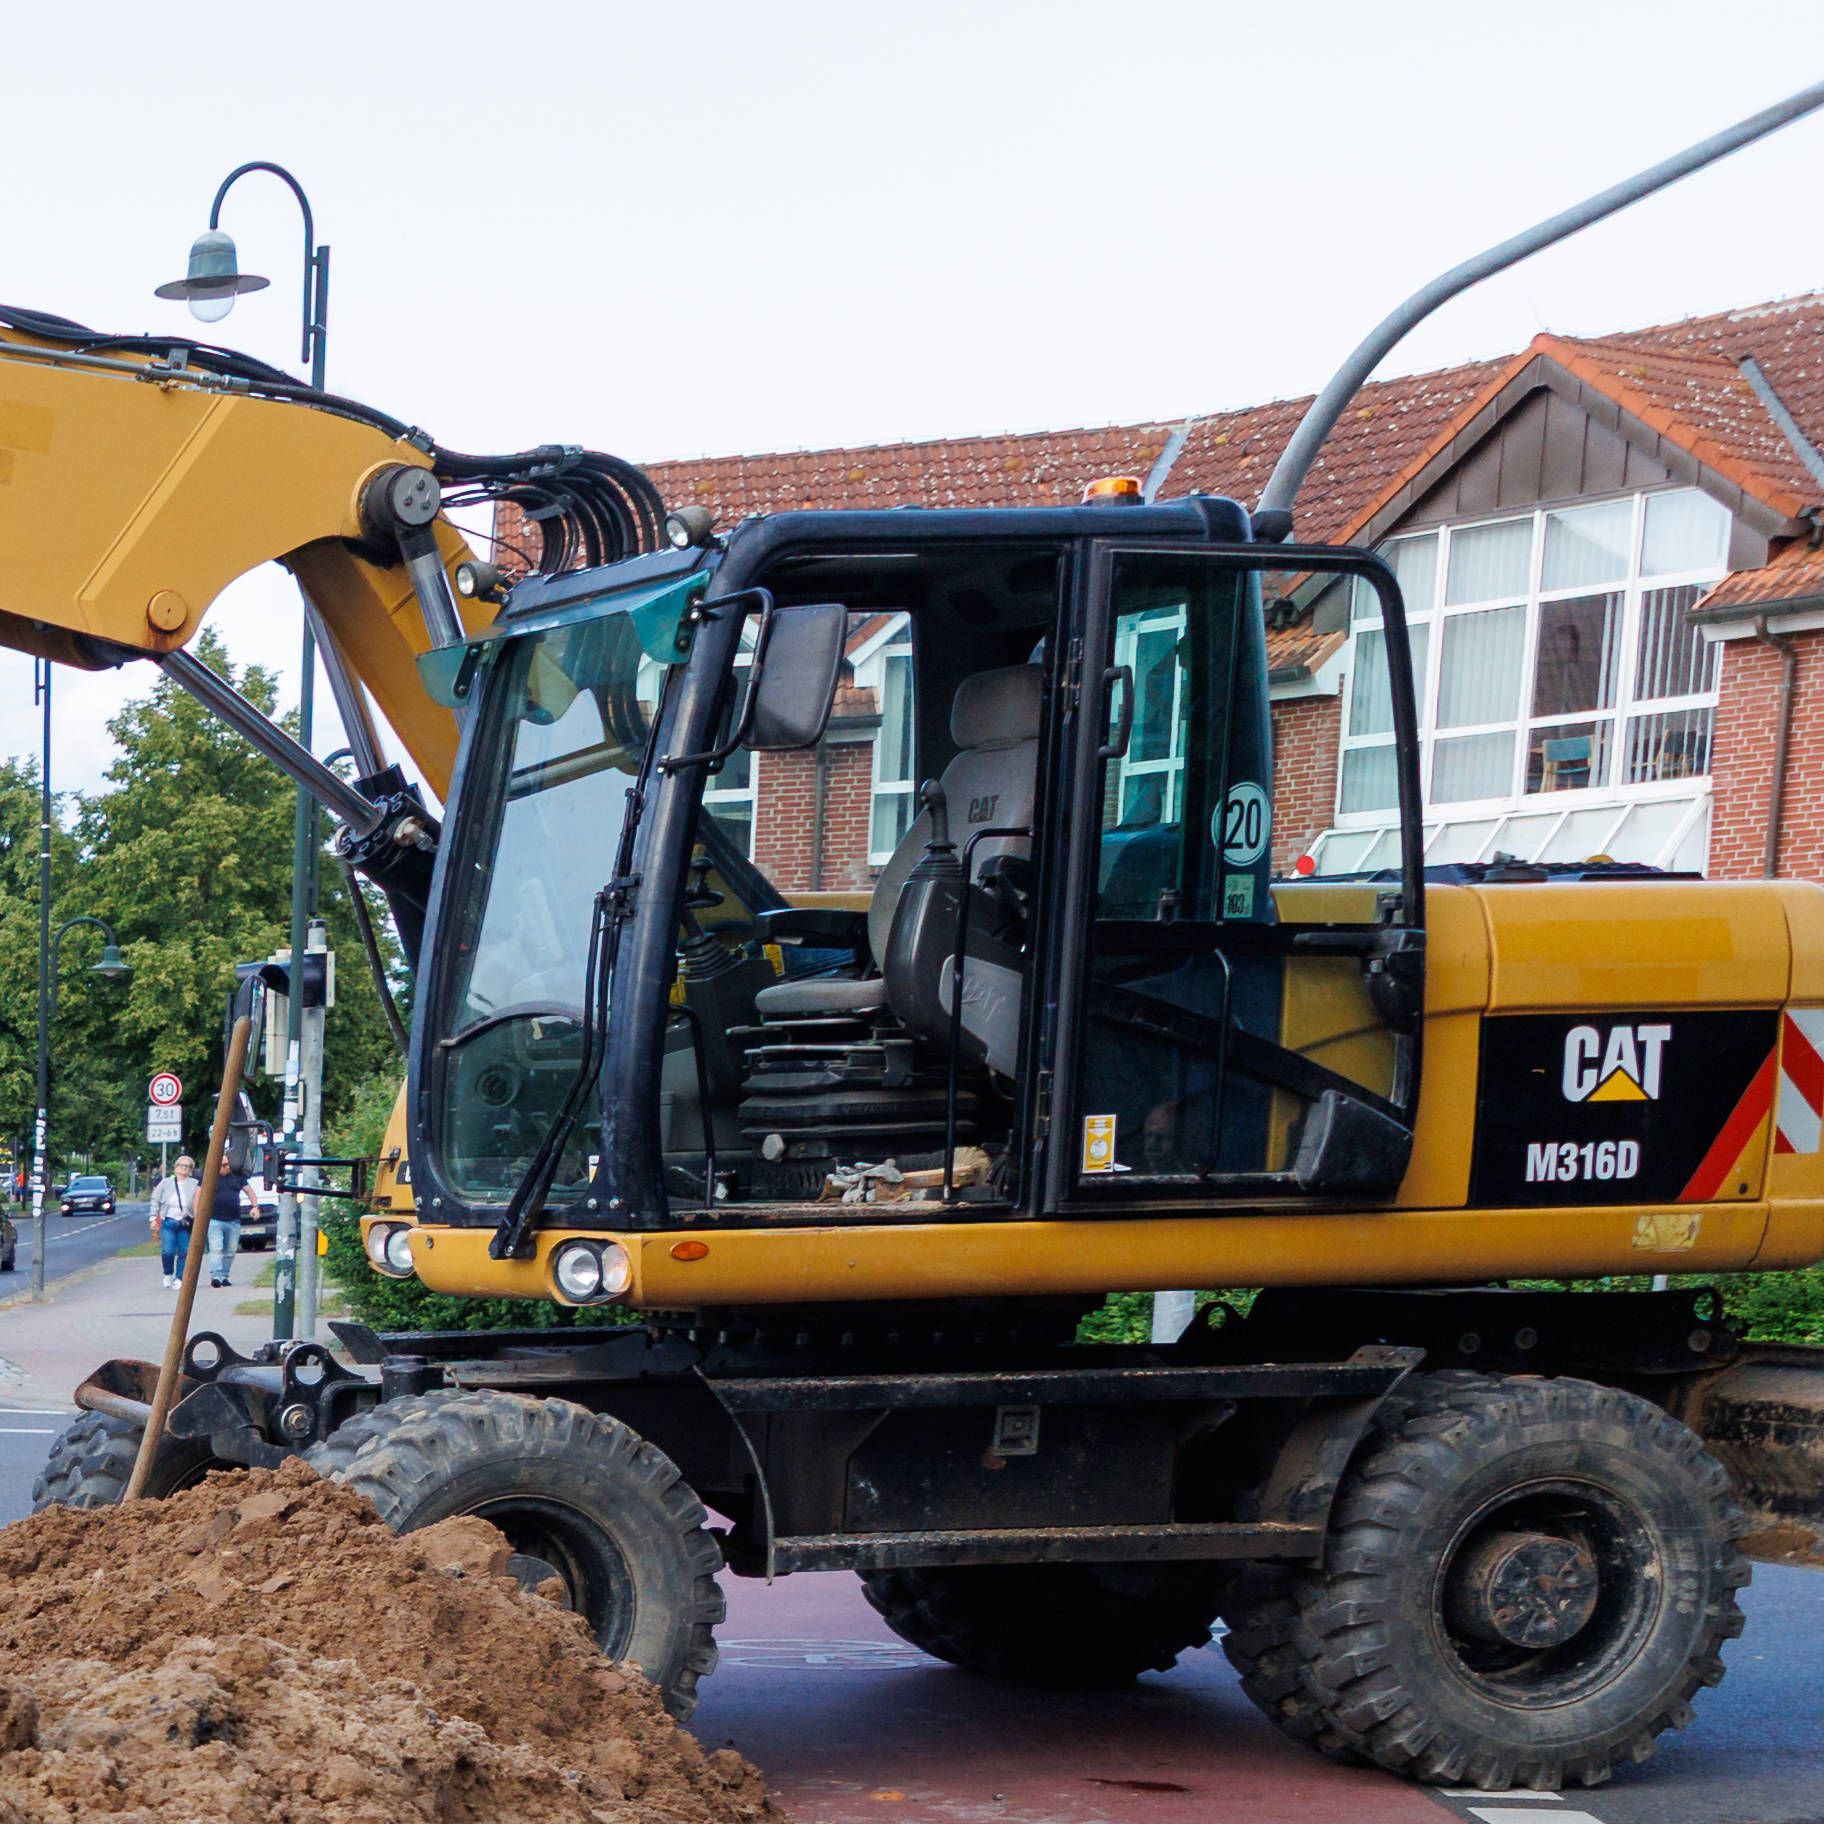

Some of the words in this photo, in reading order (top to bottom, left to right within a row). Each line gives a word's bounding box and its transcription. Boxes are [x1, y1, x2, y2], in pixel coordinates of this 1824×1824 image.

[968, 795, 1000, 824] CAT
[1225, 798, 1262, 850] 20
[1562, 1024, 1672, 1102] CAT
[156, 1082, 174, 1097] 30
[1525, 1140, 1640, 1182] M316D
